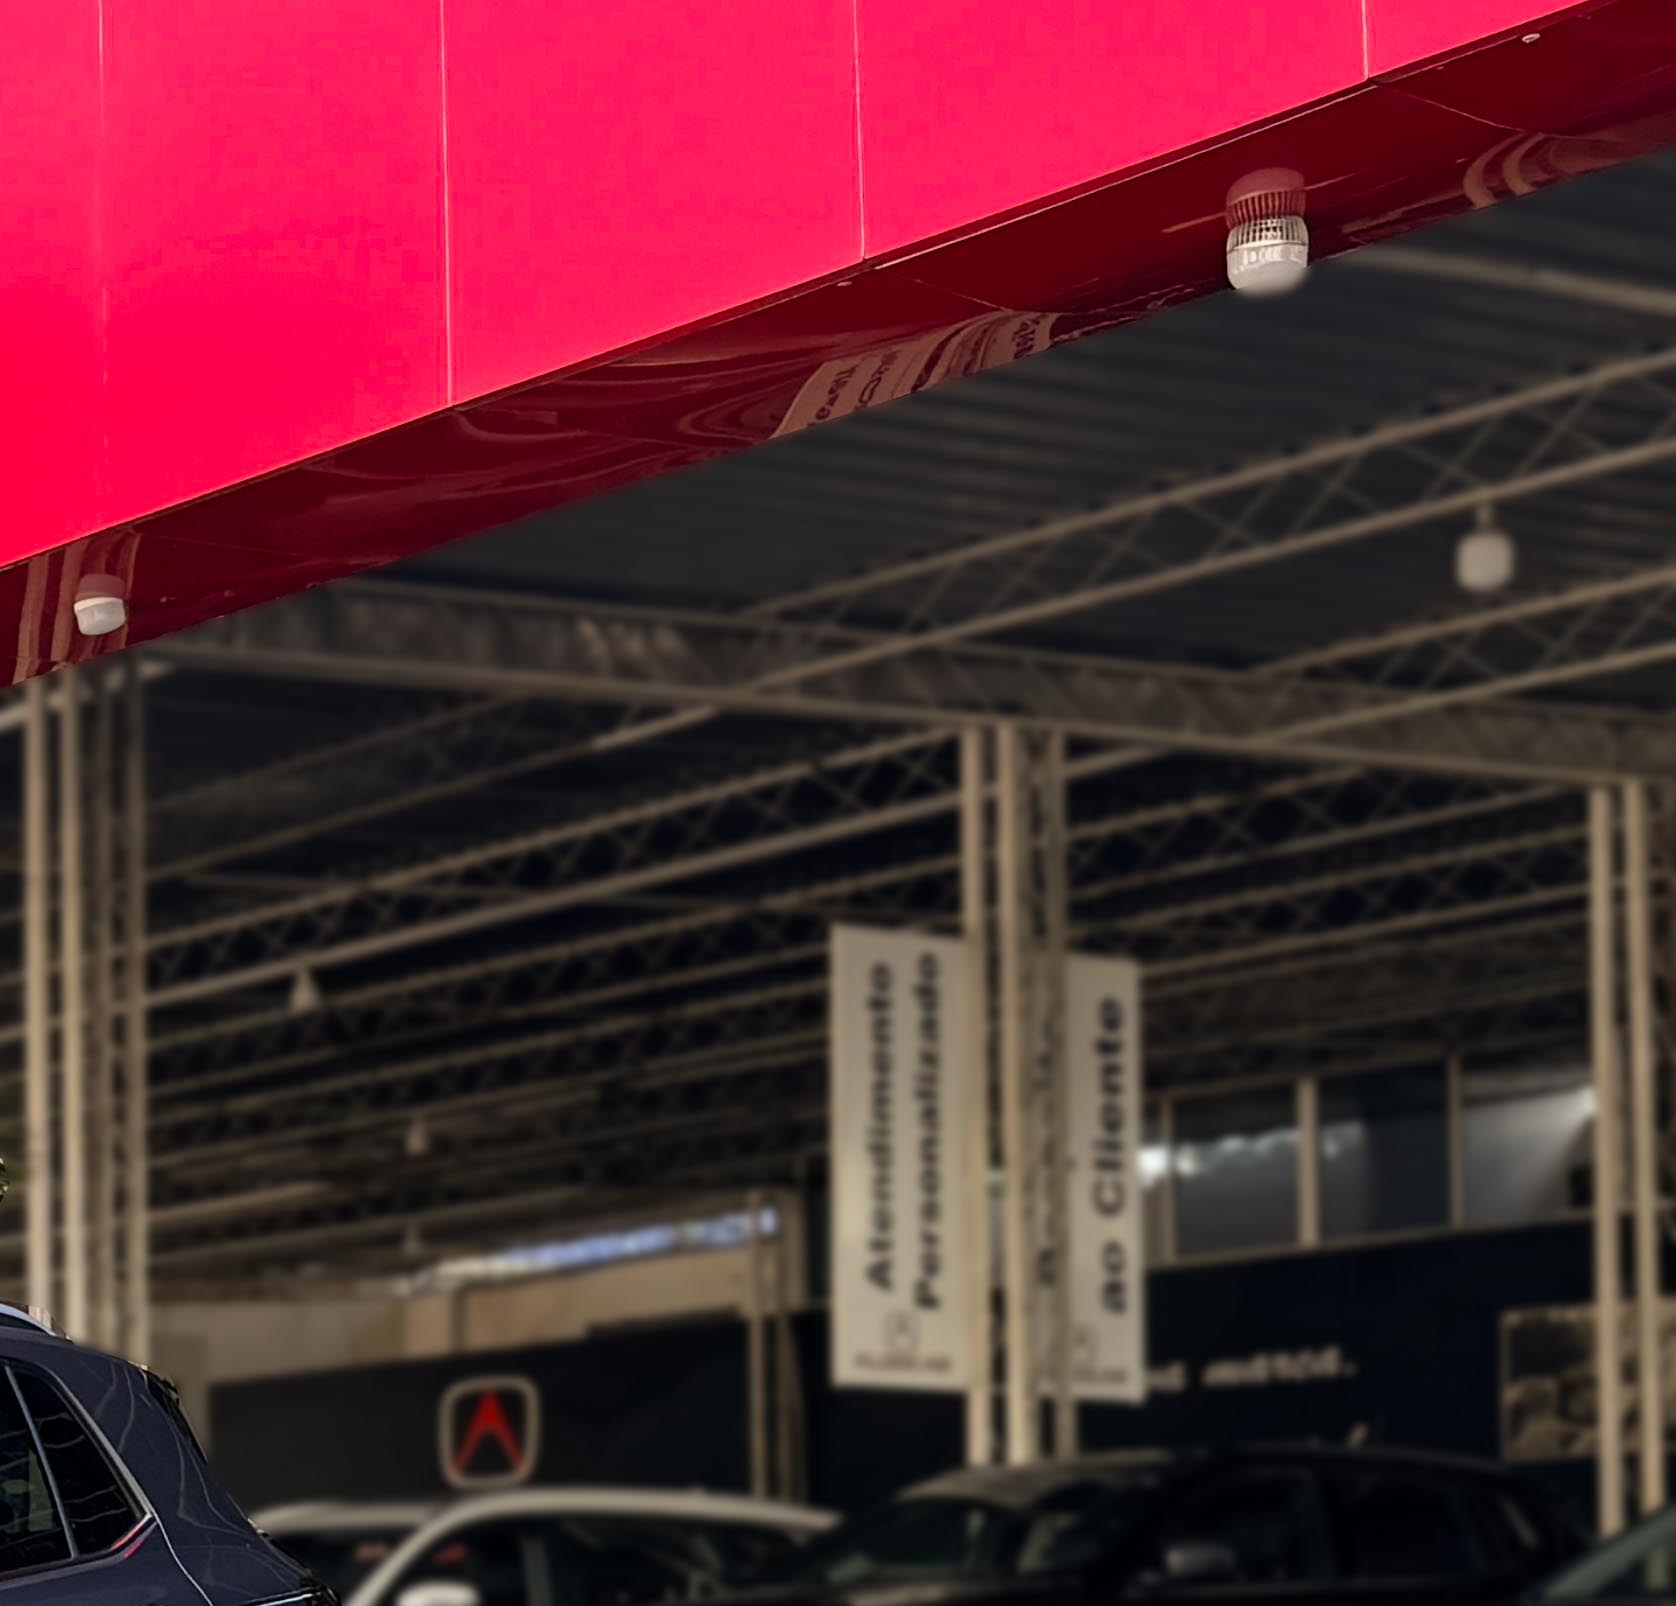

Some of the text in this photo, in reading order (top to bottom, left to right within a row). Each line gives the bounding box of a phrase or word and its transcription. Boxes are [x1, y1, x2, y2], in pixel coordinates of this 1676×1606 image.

[865, 962, 895, 1293] Atendimento
[914, 952, 942, 1311] Personalizado
[1093, 996, 1127, 1315] ao Cliente
